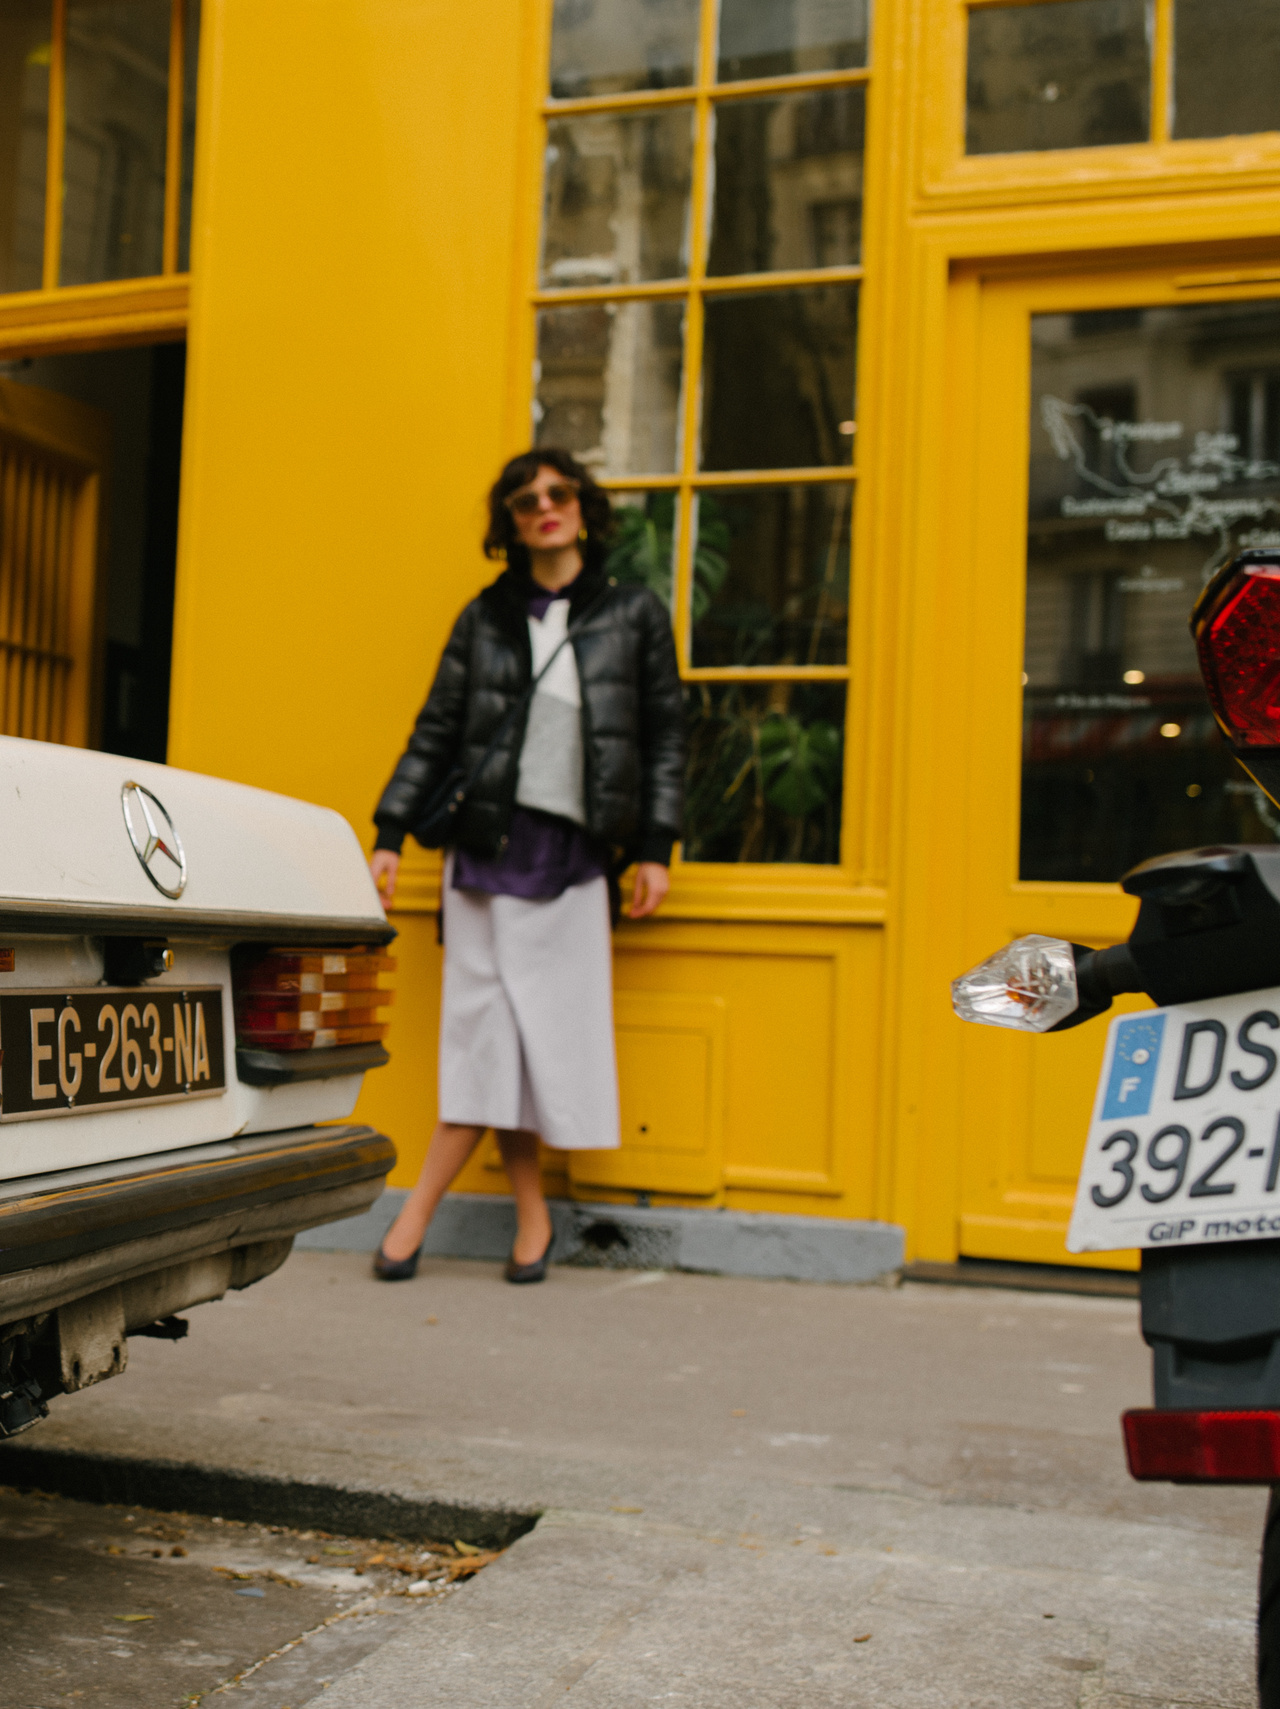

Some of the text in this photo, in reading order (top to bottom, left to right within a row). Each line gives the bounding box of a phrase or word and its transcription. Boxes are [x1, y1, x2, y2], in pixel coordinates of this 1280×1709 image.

[30, 1002, 211, 1101] EG-263-NA
[1118, 1076, 1141, 1103] F
[1091, 1109, 1280, 1208] 392-
